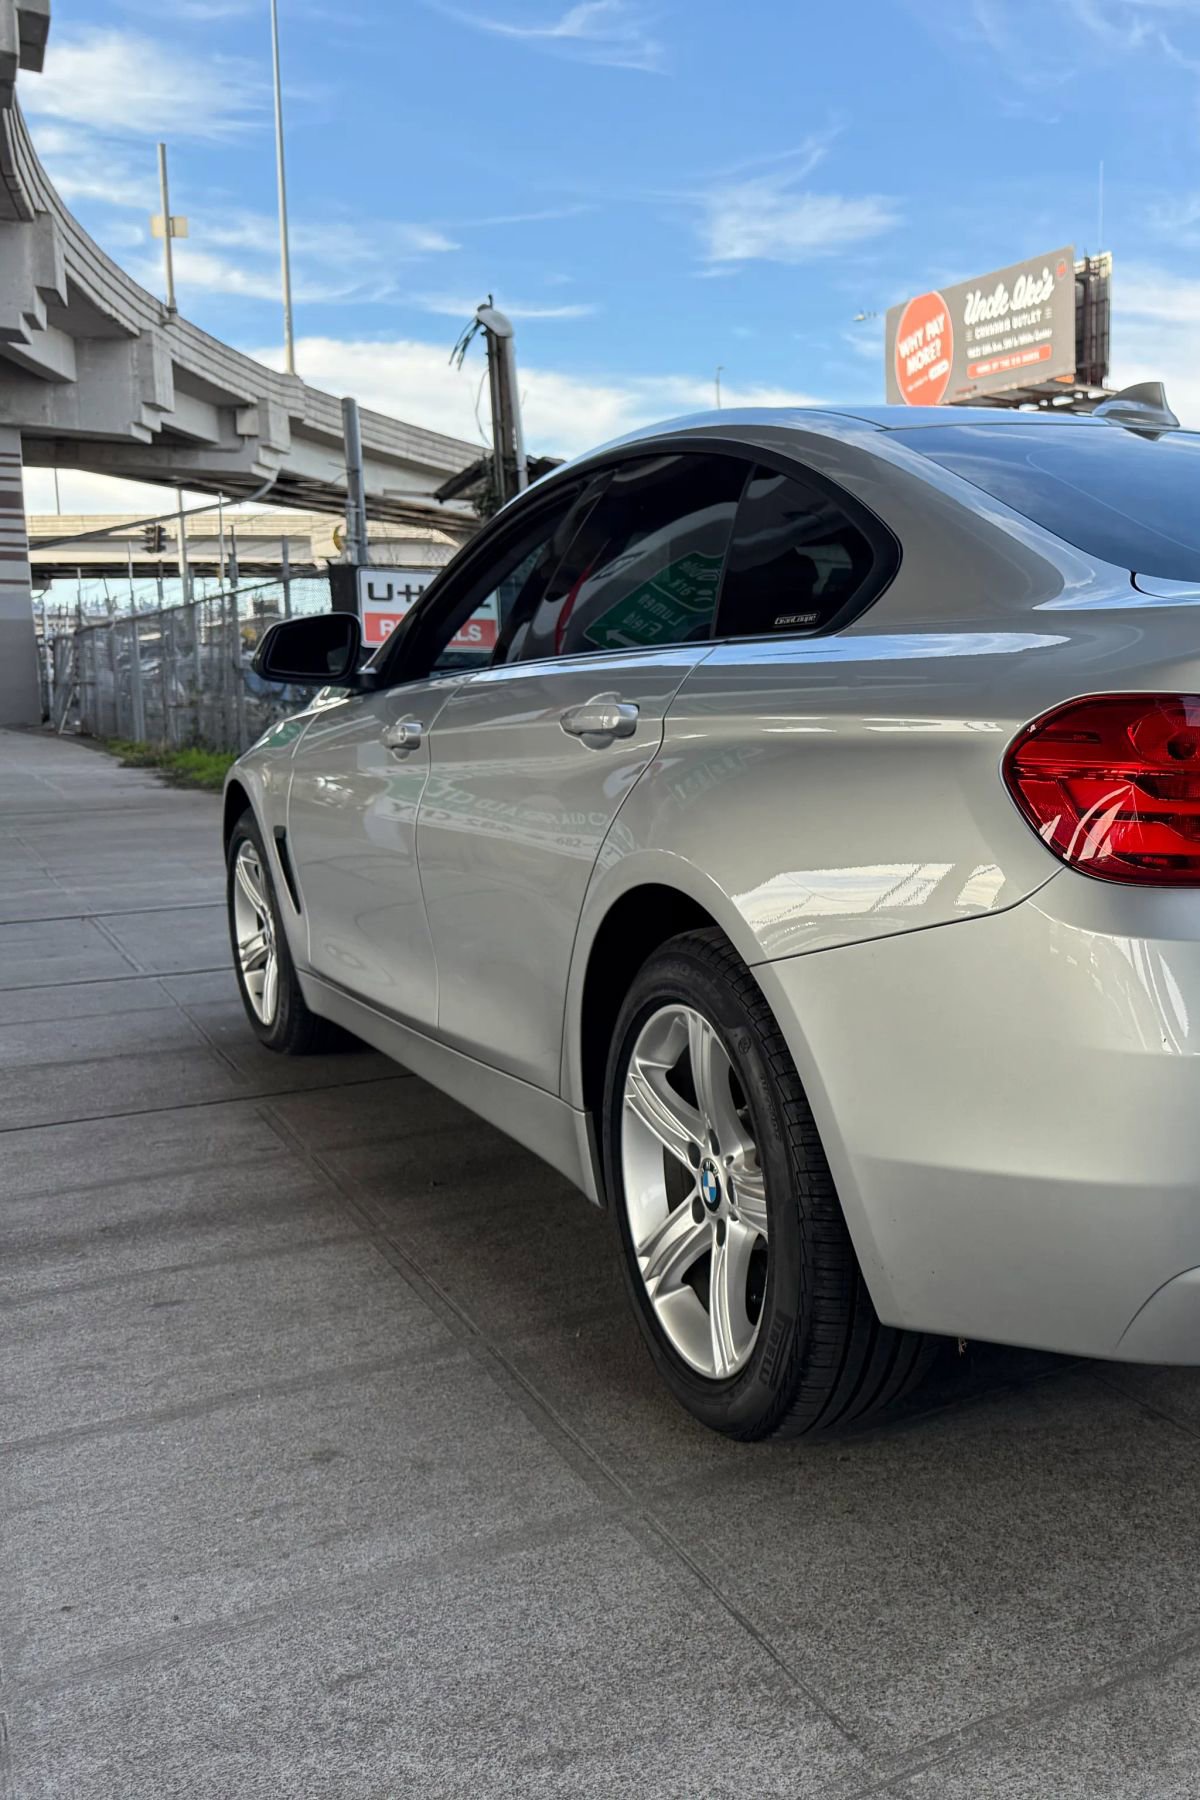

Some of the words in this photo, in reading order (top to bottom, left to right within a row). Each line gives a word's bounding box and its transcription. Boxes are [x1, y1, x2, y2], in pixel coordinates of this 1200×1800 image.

[964, 283, 1010, 325] Uncle
[898, 326, 927, 359] WHY
[925, 312, 946, 342] PAY
[906, 339, 942, 376] MORE?
